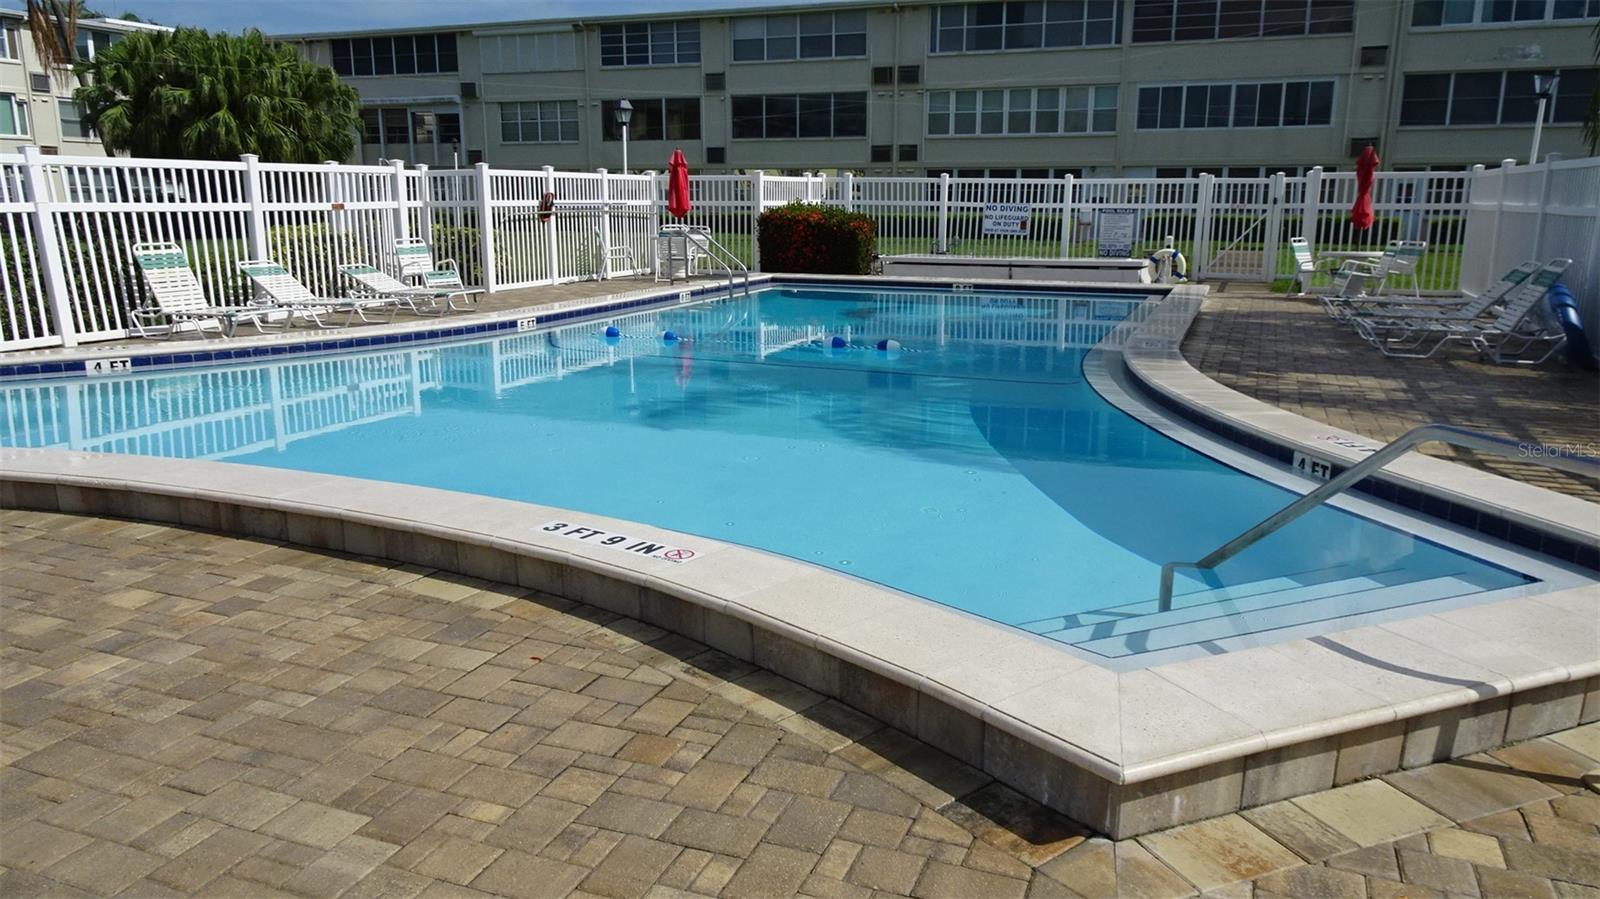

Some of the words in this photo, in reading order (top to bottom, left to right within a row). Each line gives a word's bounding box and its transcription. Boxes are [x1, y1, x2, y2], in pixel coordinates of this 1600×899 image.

[1000, 205, 1029, 213] DIVING
[109, 360, 129, 370] FT
[1297, 457, 1306, 470] 4
[1311, 460, 1330, 478] FT
[543, 522, 569, 532] 3
[563, 526, 605, 540] FT
[600, 535, 627, 546] 9
[625, 541, 664, 555] IN
